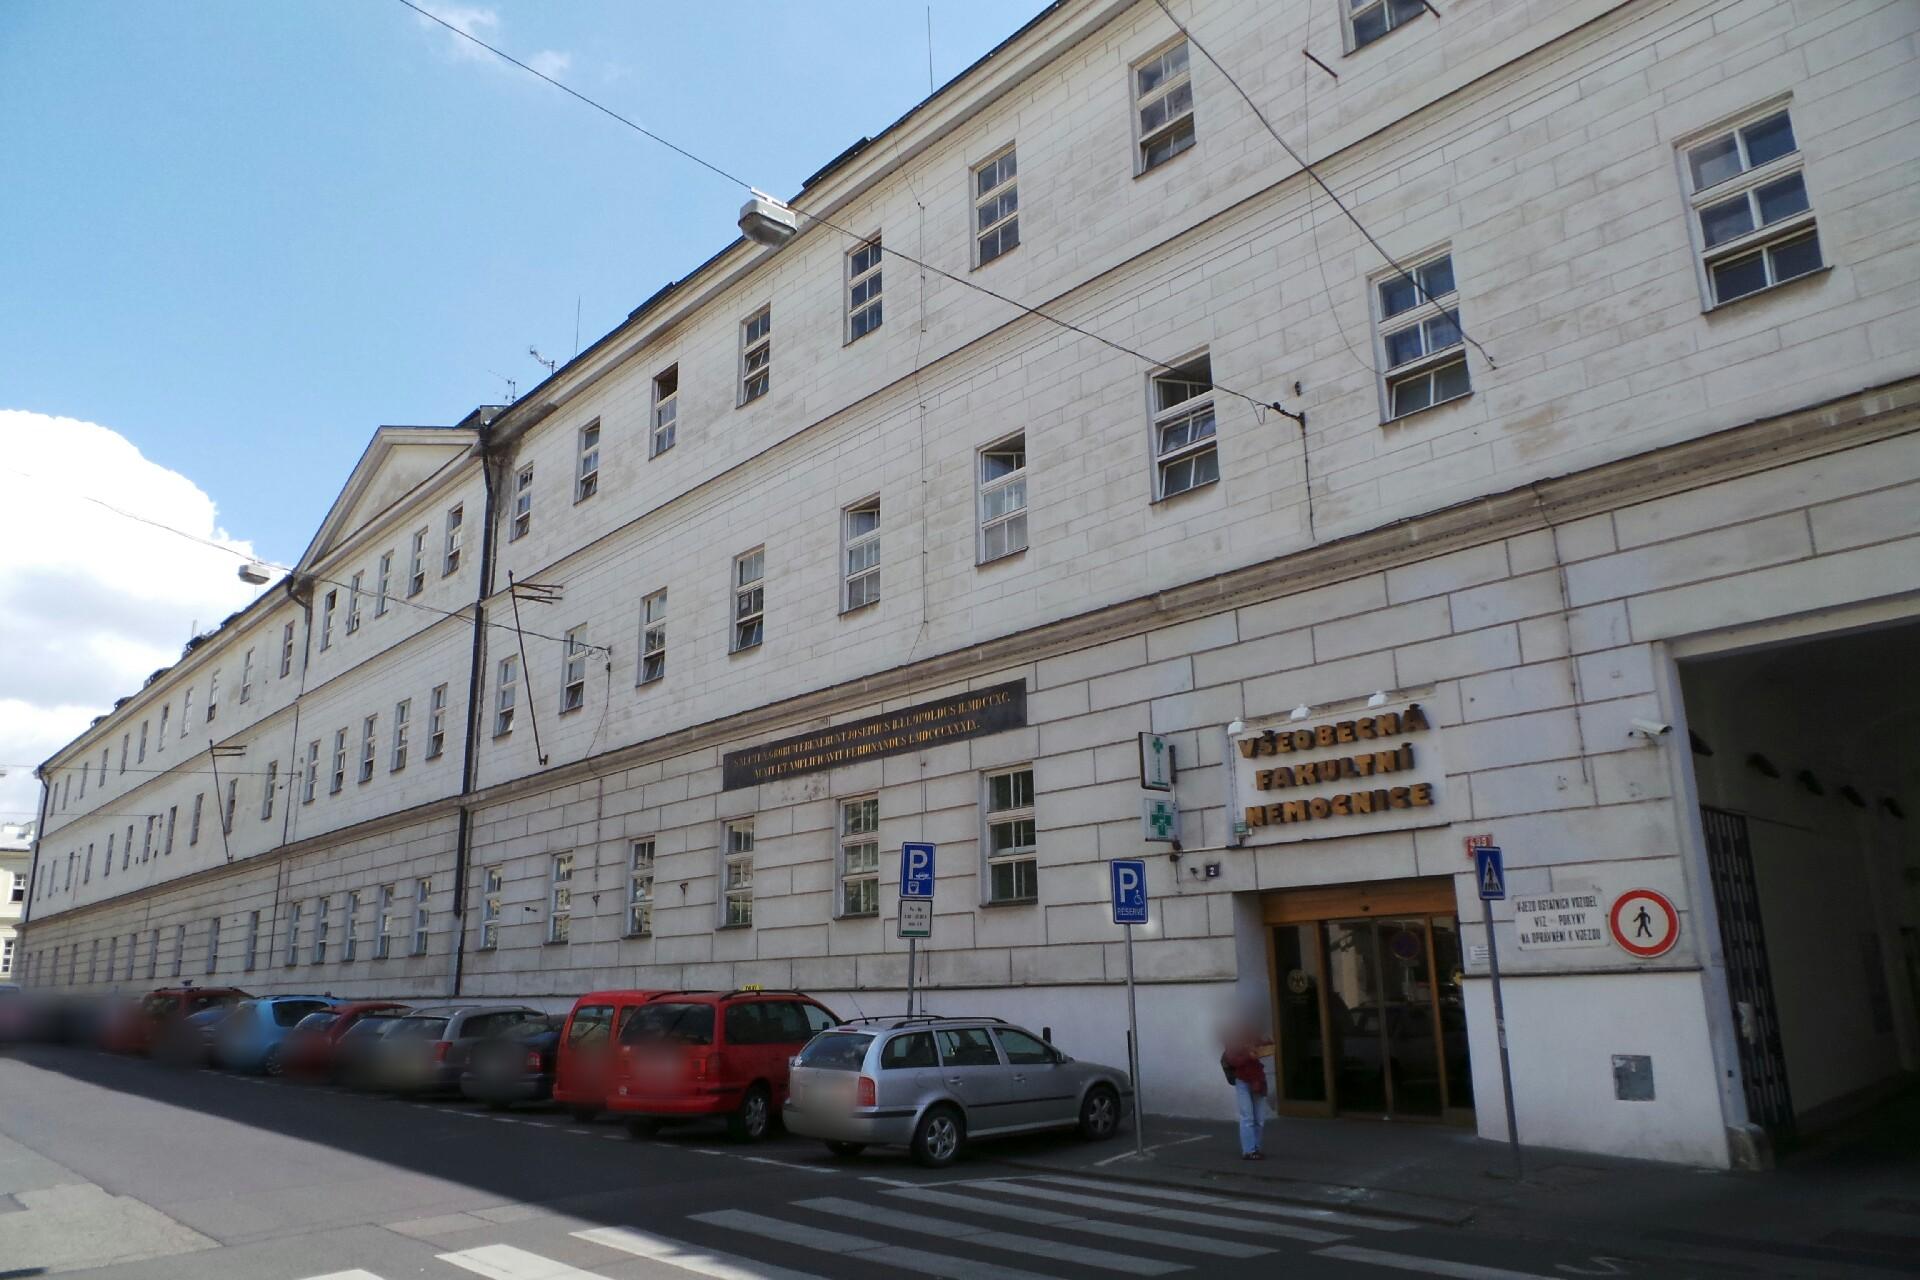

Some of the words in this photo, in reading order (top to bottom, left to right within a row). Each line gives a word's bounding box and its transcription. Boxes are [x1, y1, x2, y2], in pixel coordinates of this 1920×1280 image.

[845, 736, 907, 760] FERDINANDUS
[1238, 703, 1430, 759] VŠEOBECNÁ
[1255, 742, 1415, 791] FAKULTNÍ
[1245, 782, 1435, 827] NEMOCNICE
[908, 849, 928, 880] P
[1119, 868, 1138, 903] P
